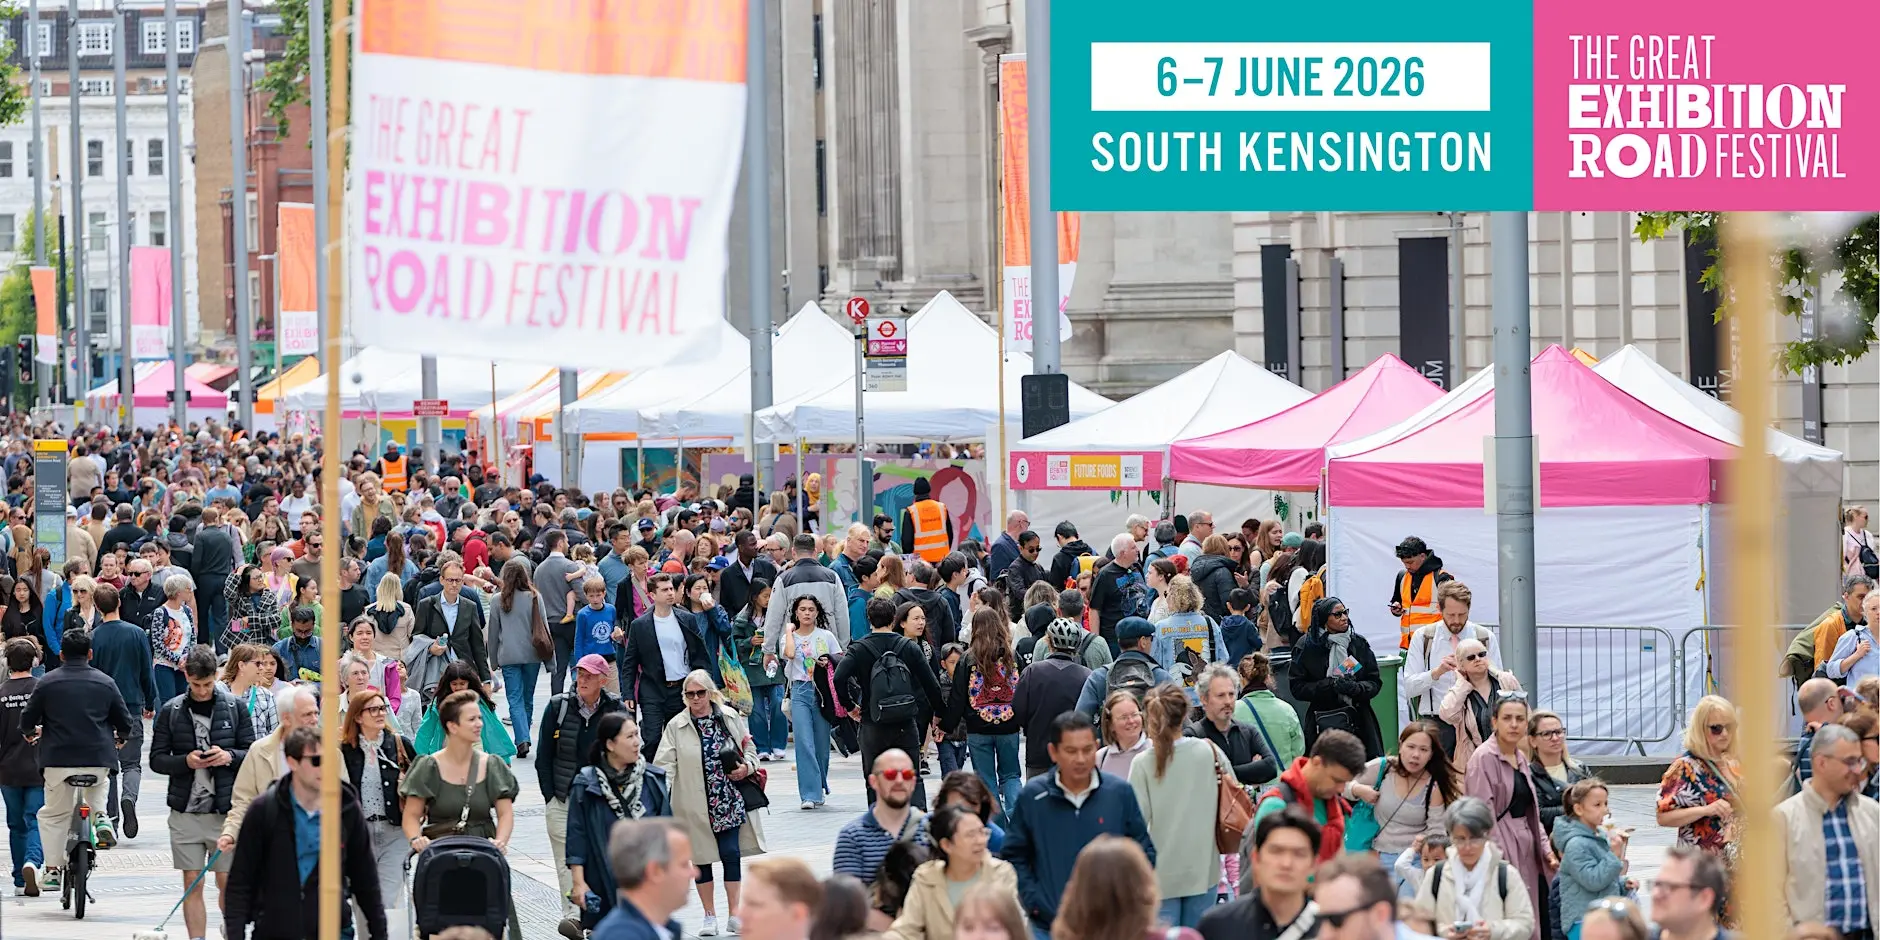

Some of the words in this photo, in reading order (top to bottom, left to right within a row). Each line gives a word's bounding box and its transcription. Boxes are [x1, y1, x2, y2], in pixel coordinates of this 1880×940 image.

[369, 94, 411, 165] THE
[416, 100, 533, 176] GREAT
[365, 169, 702, 262] EXHIBITION
[364, 245, 495, 321] ROAD
[503, 260, 686, 336] FESTIVAL
[1012, 277, 1028, 298] THE
[851, 301, 865, 317] K
[1020, 465, 1025, 476] 8
[1074, 463, 1097, 479] FUTURE
[1097, 463, 1117, 478] FOODS
